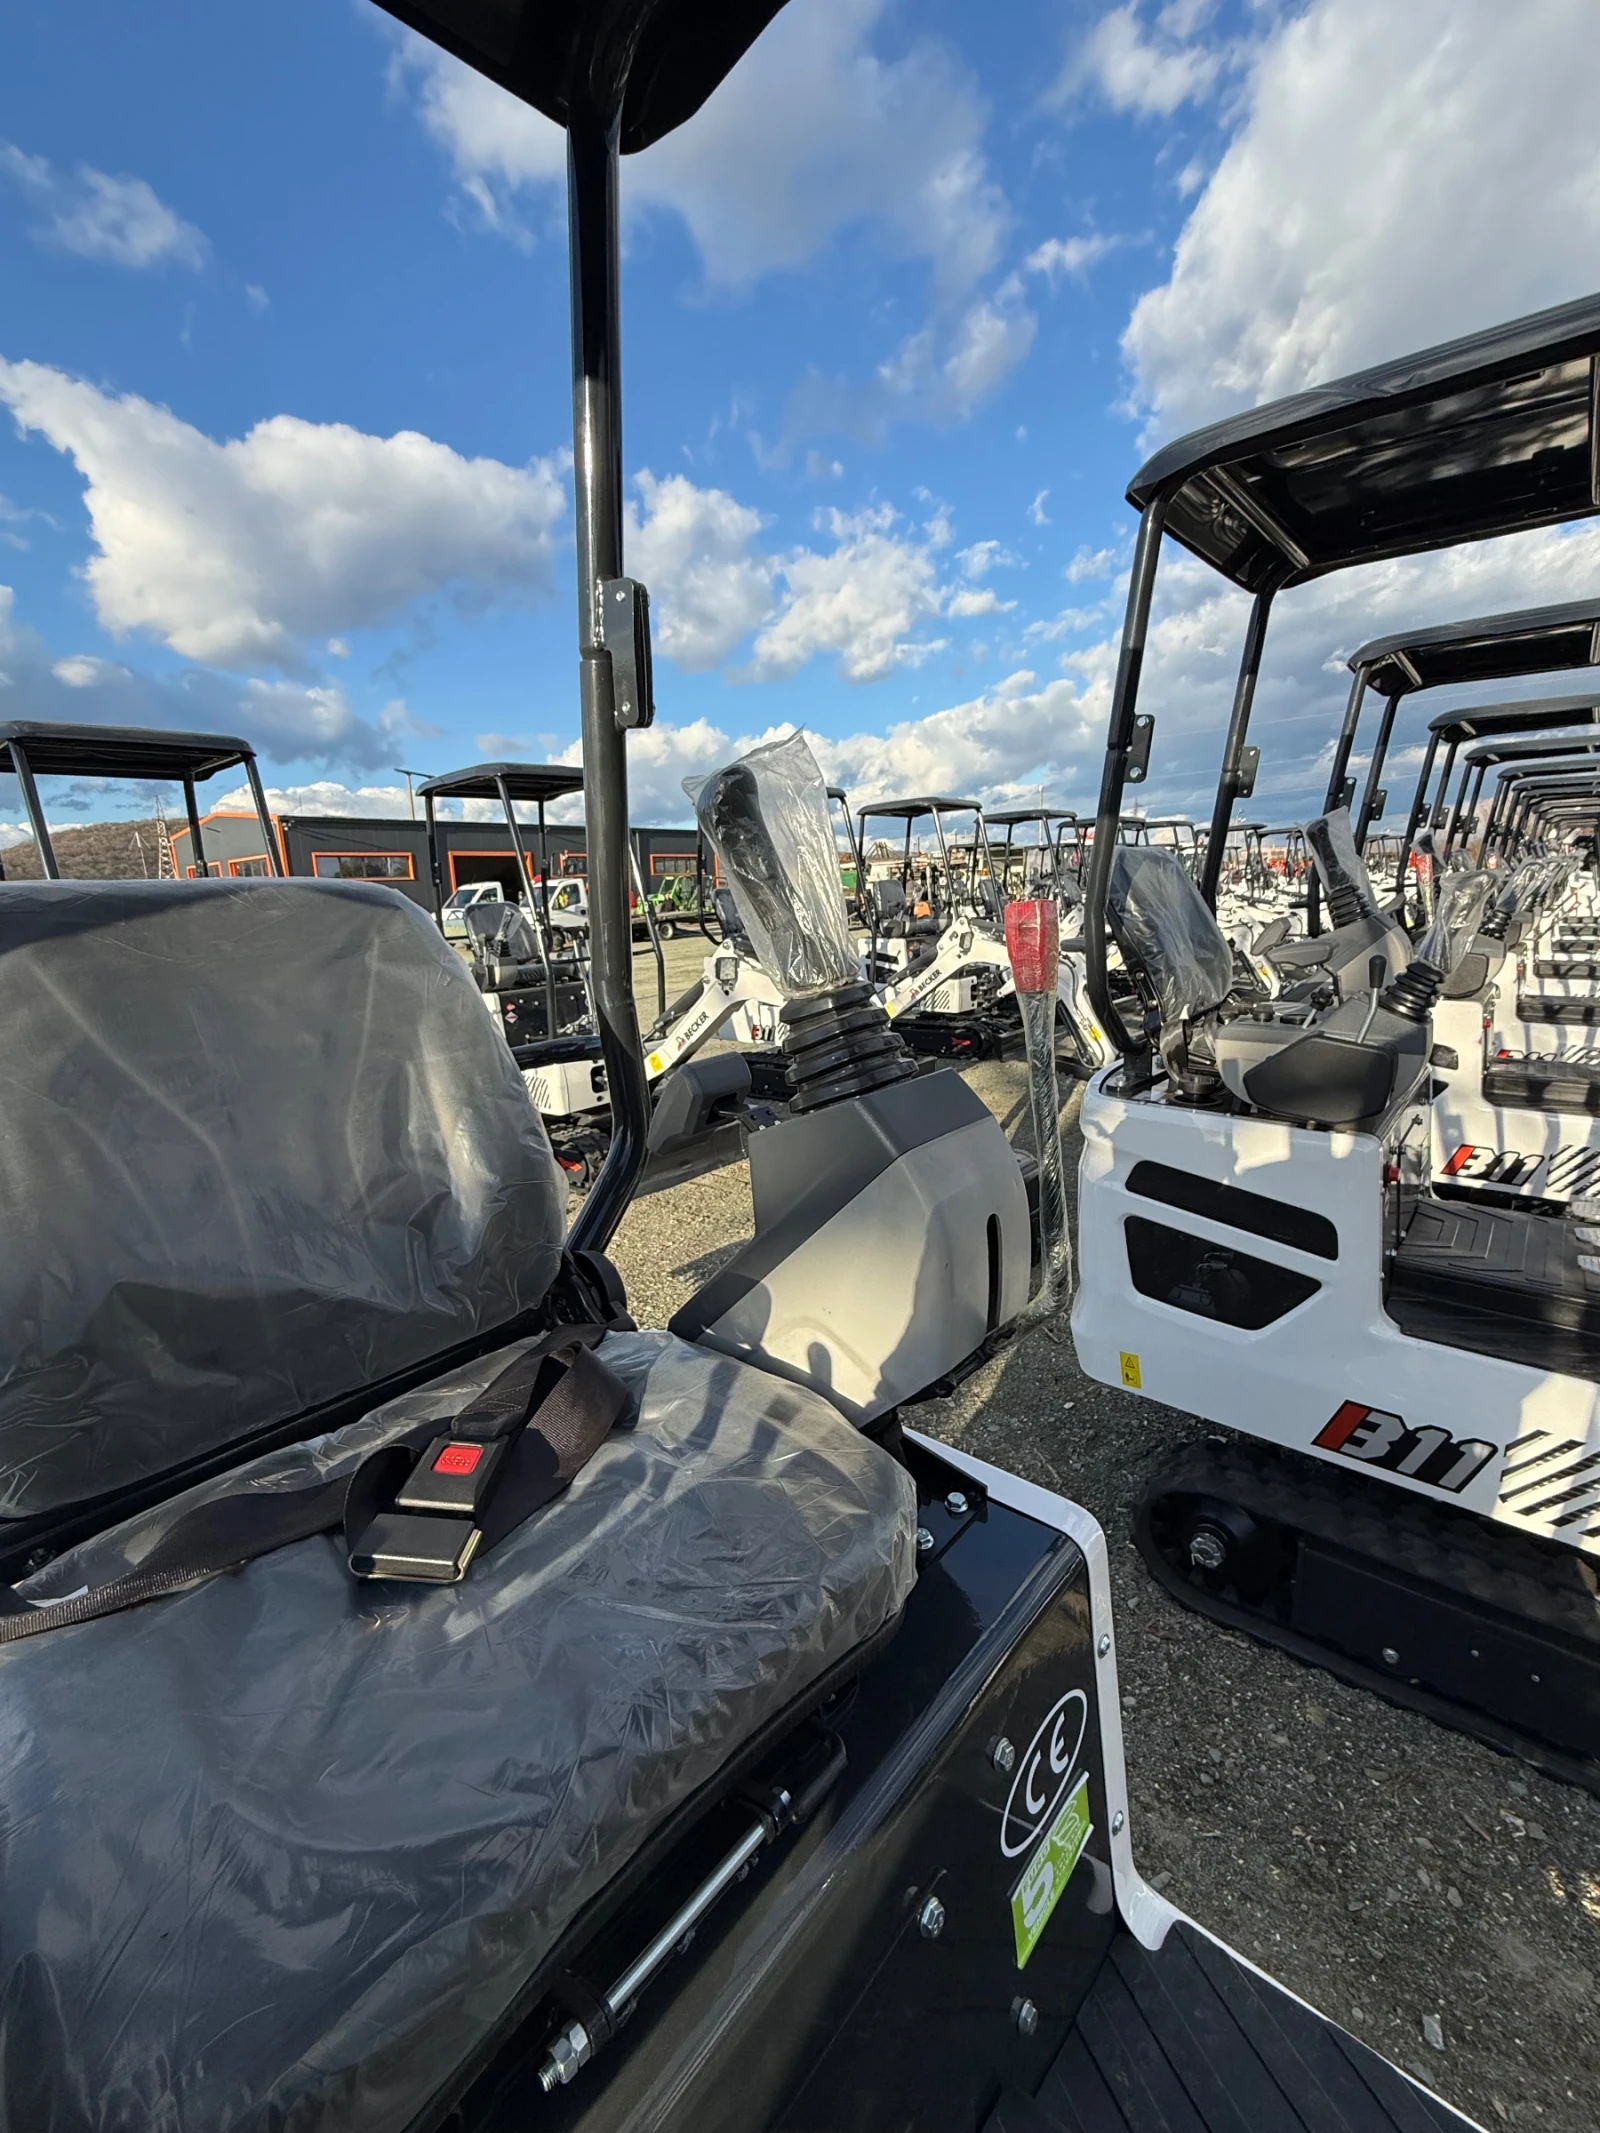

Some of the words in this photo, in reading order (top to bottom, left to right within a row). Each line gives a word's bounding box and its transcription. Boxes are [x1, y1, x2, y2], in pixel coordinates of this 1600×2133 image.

[918, 969, 942, 992] BECKER
[684, 1010, 710, 1041] BECKER
[1440, 1143, 1546, 1187] B11
[1310, 1399, 1499, 1494] B11
[1026, 1711, 1069, 1815] CE
[1021, 1861, 1054, 1928] 5
